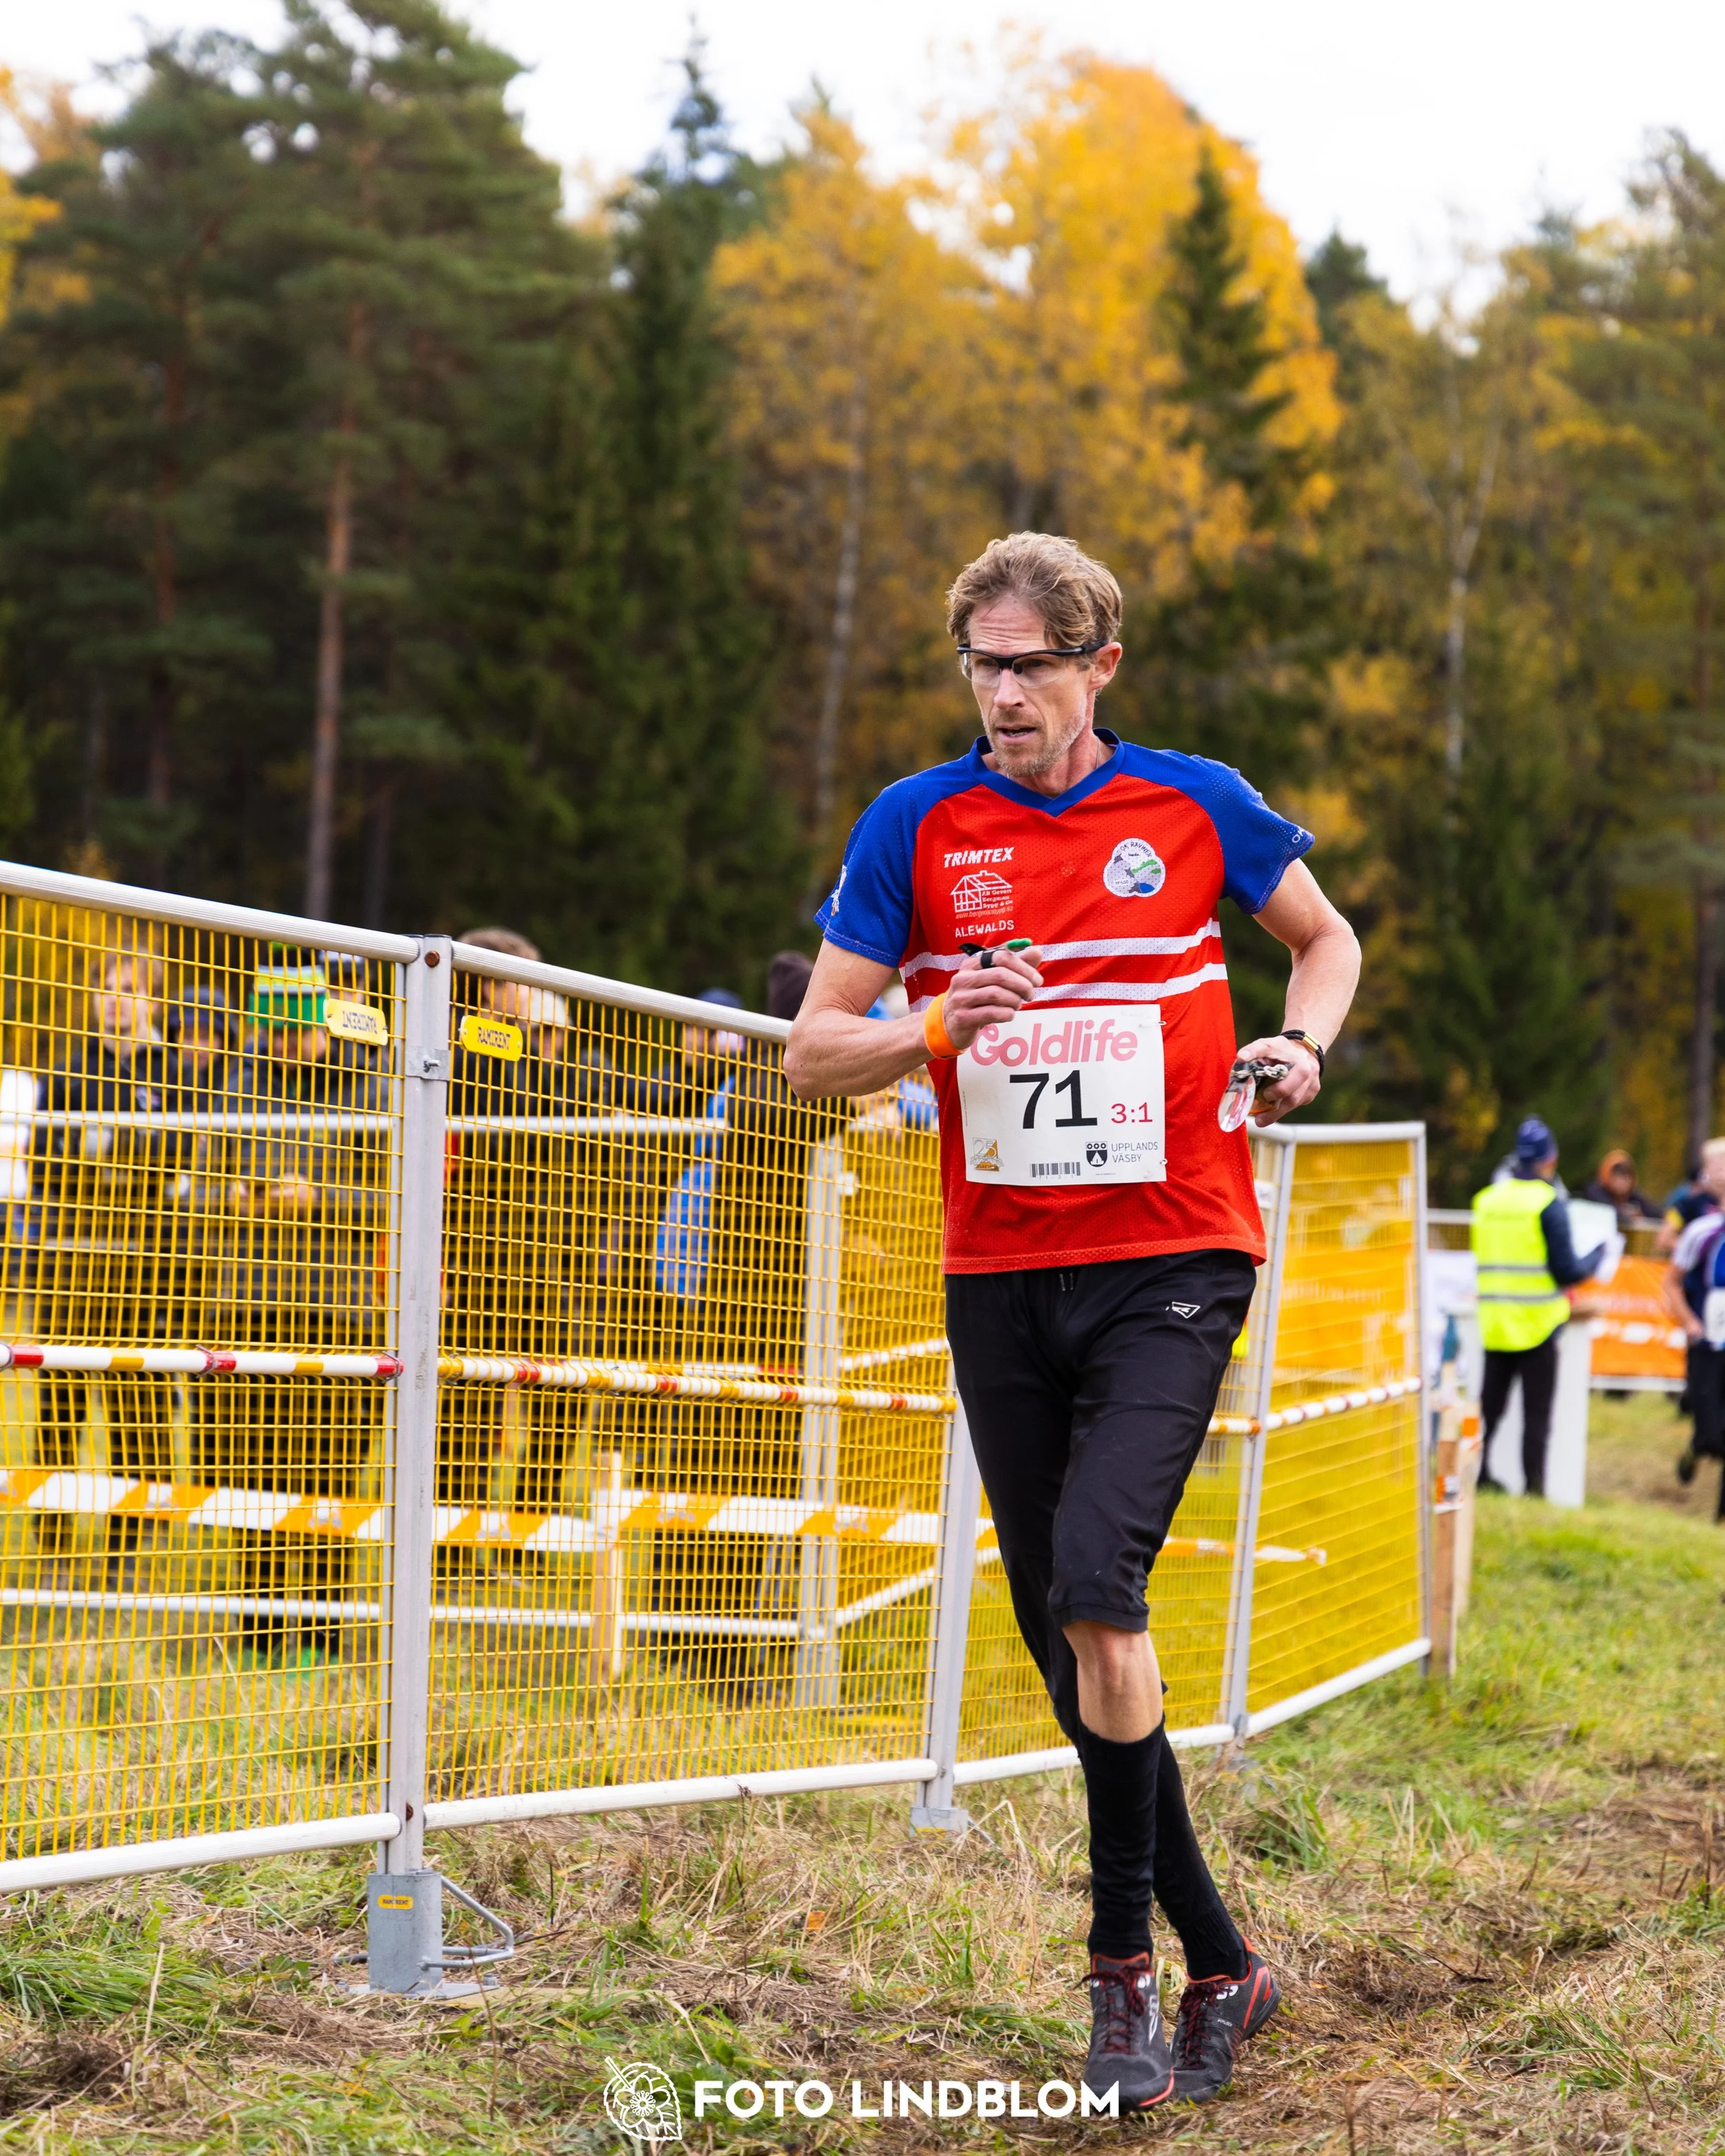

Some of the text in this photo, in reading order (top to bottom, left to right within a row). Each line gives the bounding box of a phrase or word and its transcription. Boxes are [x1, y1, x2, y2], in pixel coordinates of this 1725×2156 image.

[943, 847, 1015, 869] TRIMTEX
[955, 919, 1014, 938] ALEWALDS
[477, 1025, 511, 1051] RAMIRENT
[970, 1019, 1138, 1067] Goldlife
[1009, 1070, 1098, 1129] 71
[1111, 1102, 1153, 1125] 3:1
[1111, 1141, 1159, 1152] UPPLANDS
[1112, 1152, 1142, 1163] VÄSBY
